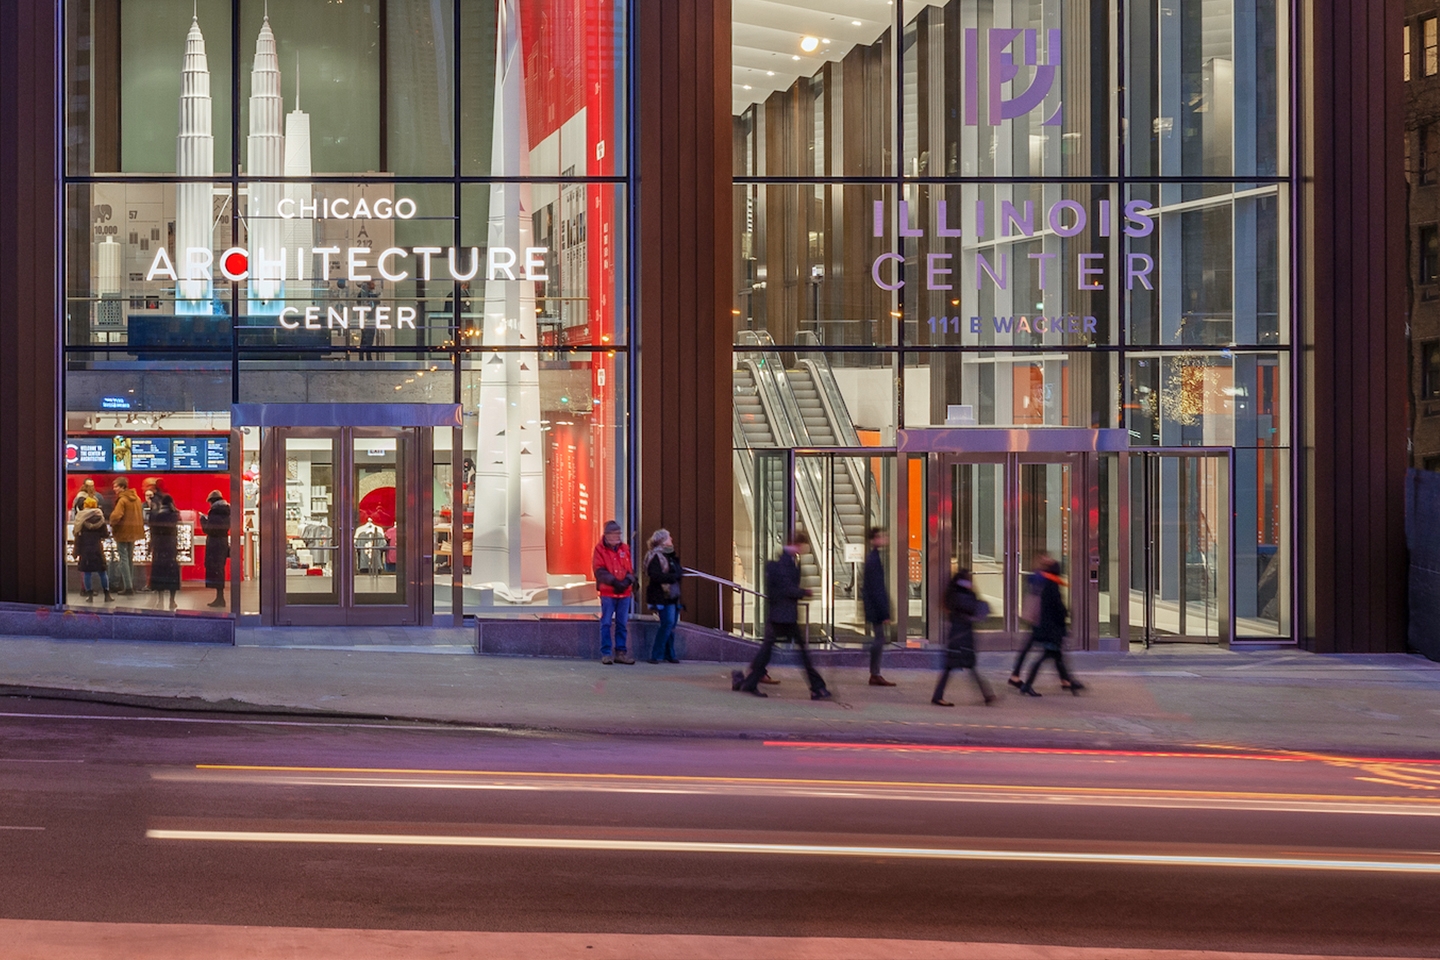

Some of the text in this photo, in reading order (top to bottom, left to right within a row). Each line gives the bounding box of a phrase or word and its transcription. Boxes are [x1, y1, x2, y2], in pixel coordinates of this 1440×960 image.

[128, 210, 138, 220] 57
[277, 197, 417, 220] CHICAGO
[873, 199, 1155, 238] ILLINOIS
[94, 225, 118, 236] 10,000
[146, 245, 550, 281] ARCHITECTURE
[871, 252, 1155, 291] CENTER
[279, 306, 416, 329] CENTER
[927, 316, 1098, 334] 111 E WACKER
